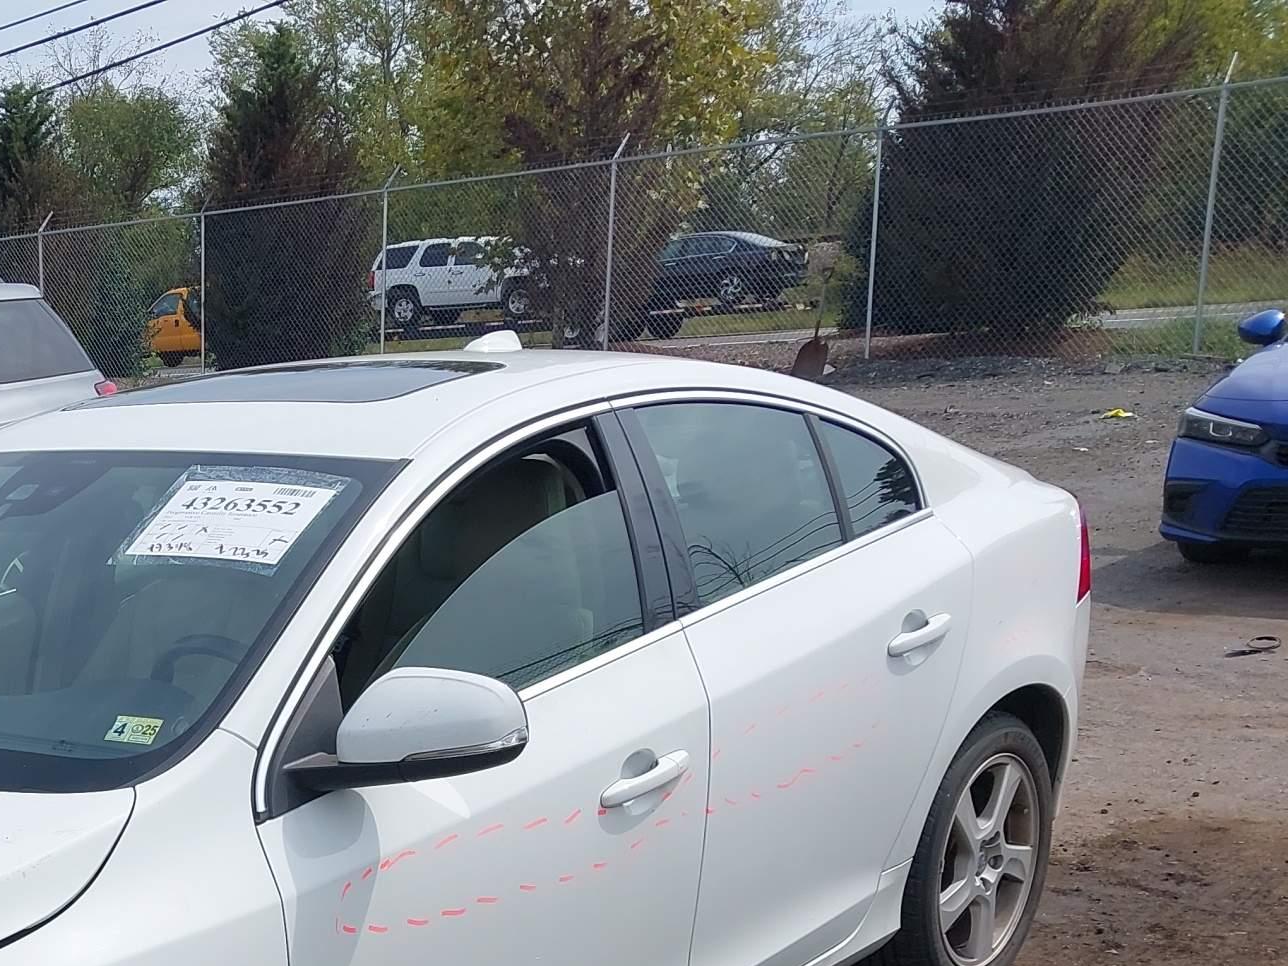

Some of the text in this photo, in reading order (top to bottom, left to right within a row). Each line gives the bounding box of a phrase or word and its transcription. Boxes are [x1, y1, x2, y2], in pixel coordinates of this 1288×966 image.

[181, 496, 302, 516] 43263552
[112, 722, 160, 737] 4 25
